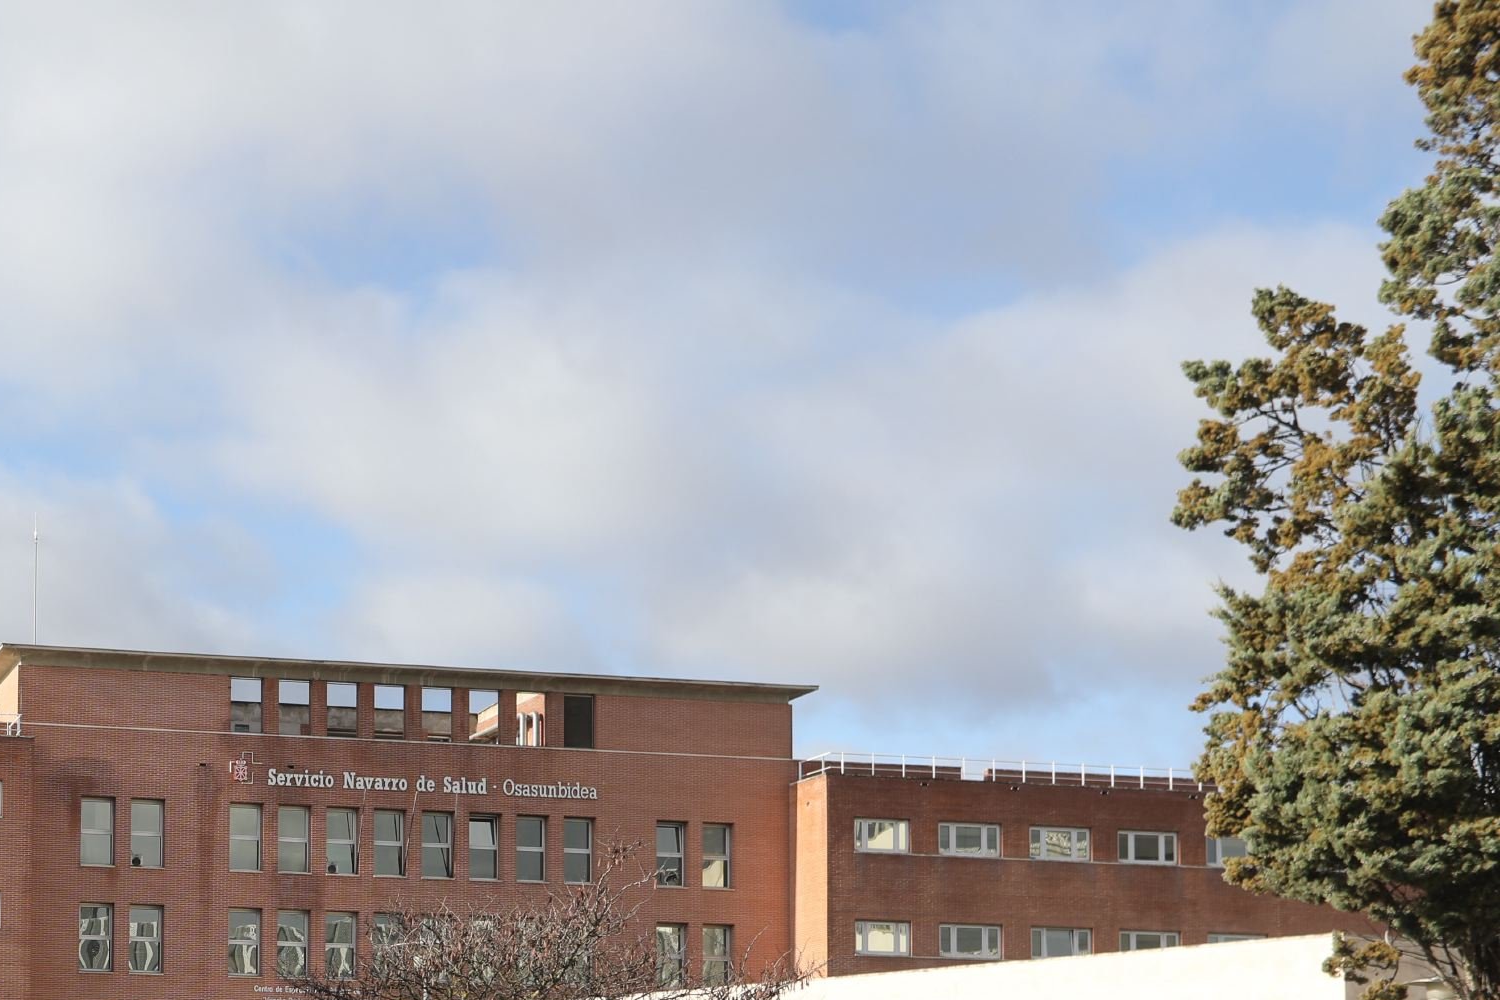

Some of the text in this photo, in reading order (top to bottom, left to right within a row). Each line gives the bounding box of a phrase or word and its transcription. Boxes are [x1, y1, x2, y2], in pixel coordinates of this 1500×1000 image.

[267, 768, 598, 800] Servicio Navarro de Salud Osasunbidea
